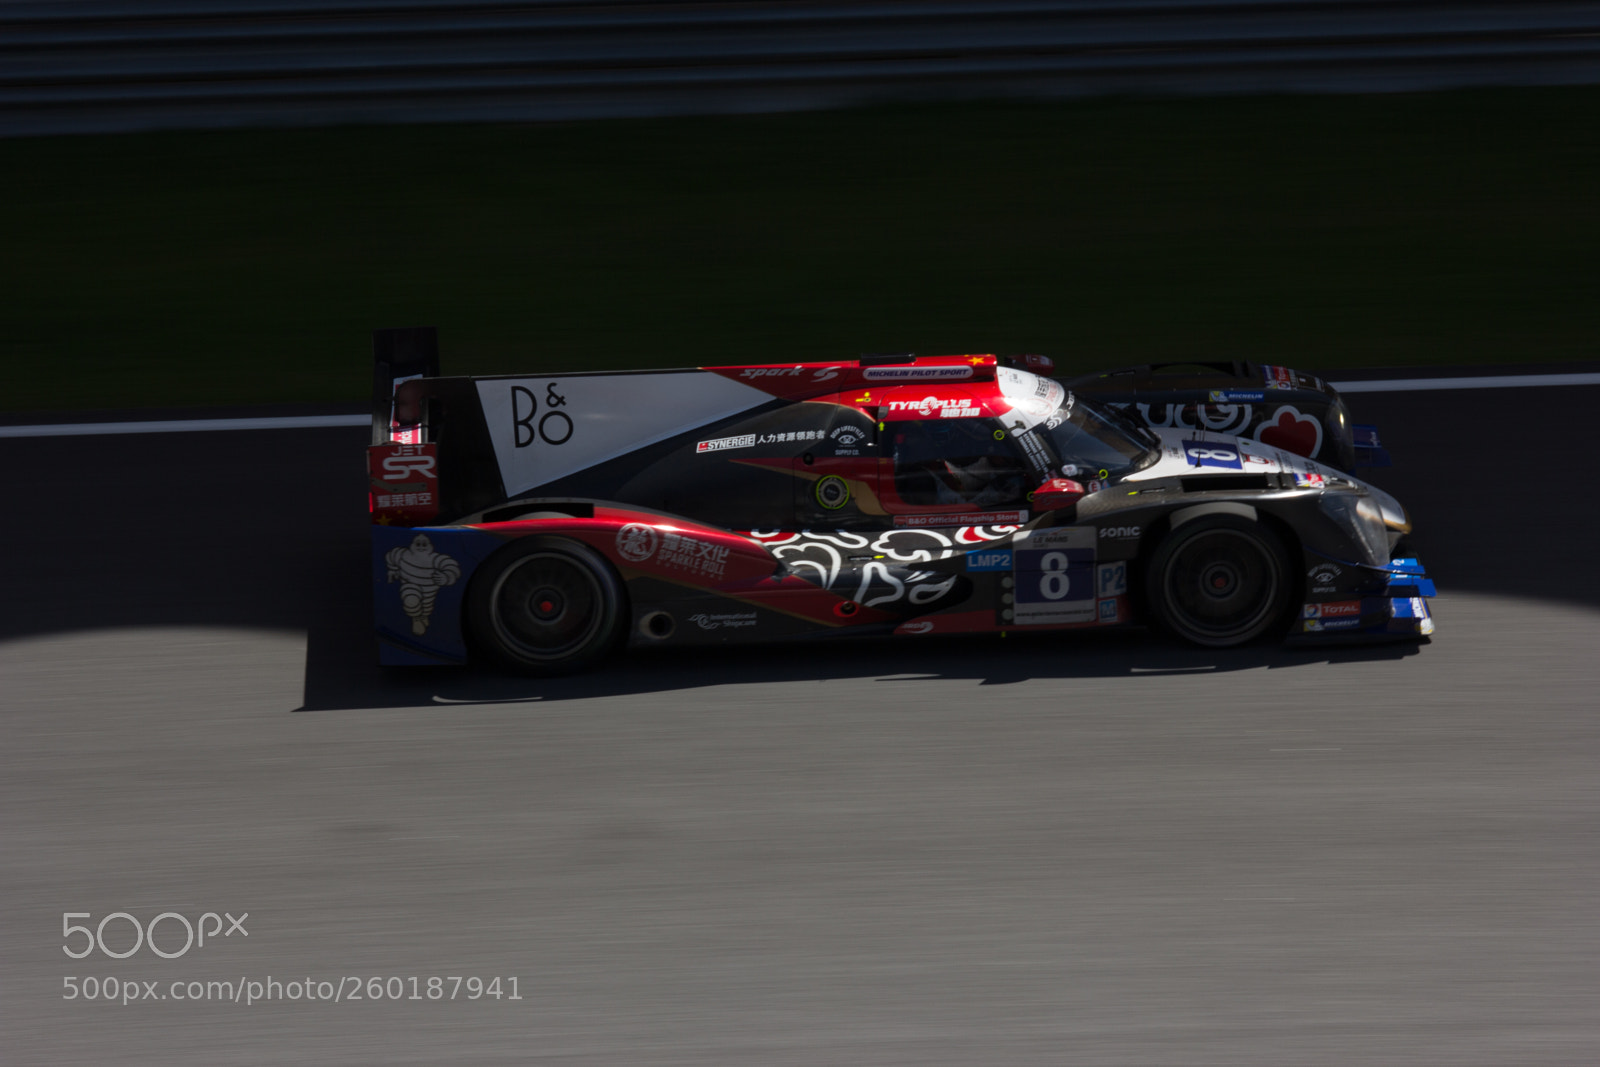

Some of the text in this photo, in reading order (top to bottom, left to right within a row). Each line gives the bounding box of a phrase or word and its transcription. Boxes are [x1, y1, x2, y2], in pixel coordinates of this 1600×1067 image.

[739, 365, 804, 379] spark
[867, 368, 968, 377] MICHELIN PILOT SPORT
[707, 436, 754, 450] SYNERGIE
[391, 445, 425, 456] JET
[1187, 448, 1238, 462] 8
[928, 515, 958, 524] Official
[960, 514, 994, 524] Flagship
[996, 513, 1018, 521] Store
[657, 549, 700, 569] SPARKLE
[701, 561, 725, 575] ROLL
[967, 554, 1011, 567] LMP2
[1039, 551, 1071, 600] 8
[1101, 566, 1126, 592] P2
[1323, 605, 1359, 613] TOTAL
[1323, 619, 1360, 627] MICHELIN
